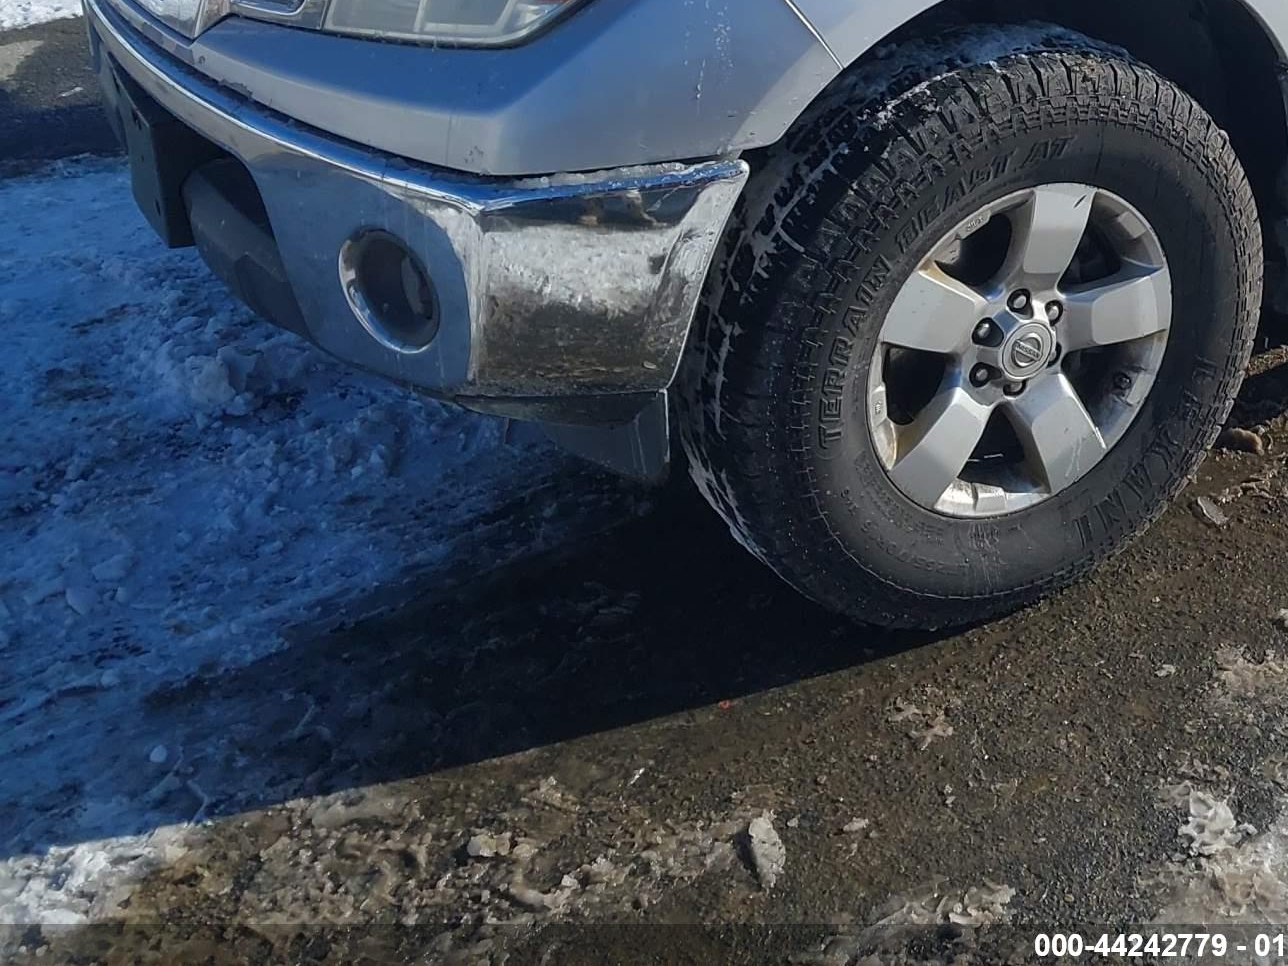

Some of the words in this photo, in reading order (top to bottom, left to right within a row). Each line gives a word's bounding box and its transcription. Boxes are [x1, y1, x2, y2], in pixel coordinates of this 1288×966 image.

[817, 253, 892, 452] TERRAIN
[897, 148, 1013, 254] BEAST
[1020, 136, 1075, 169] AT
[1013, 339, 1042, 361] NISSAN
